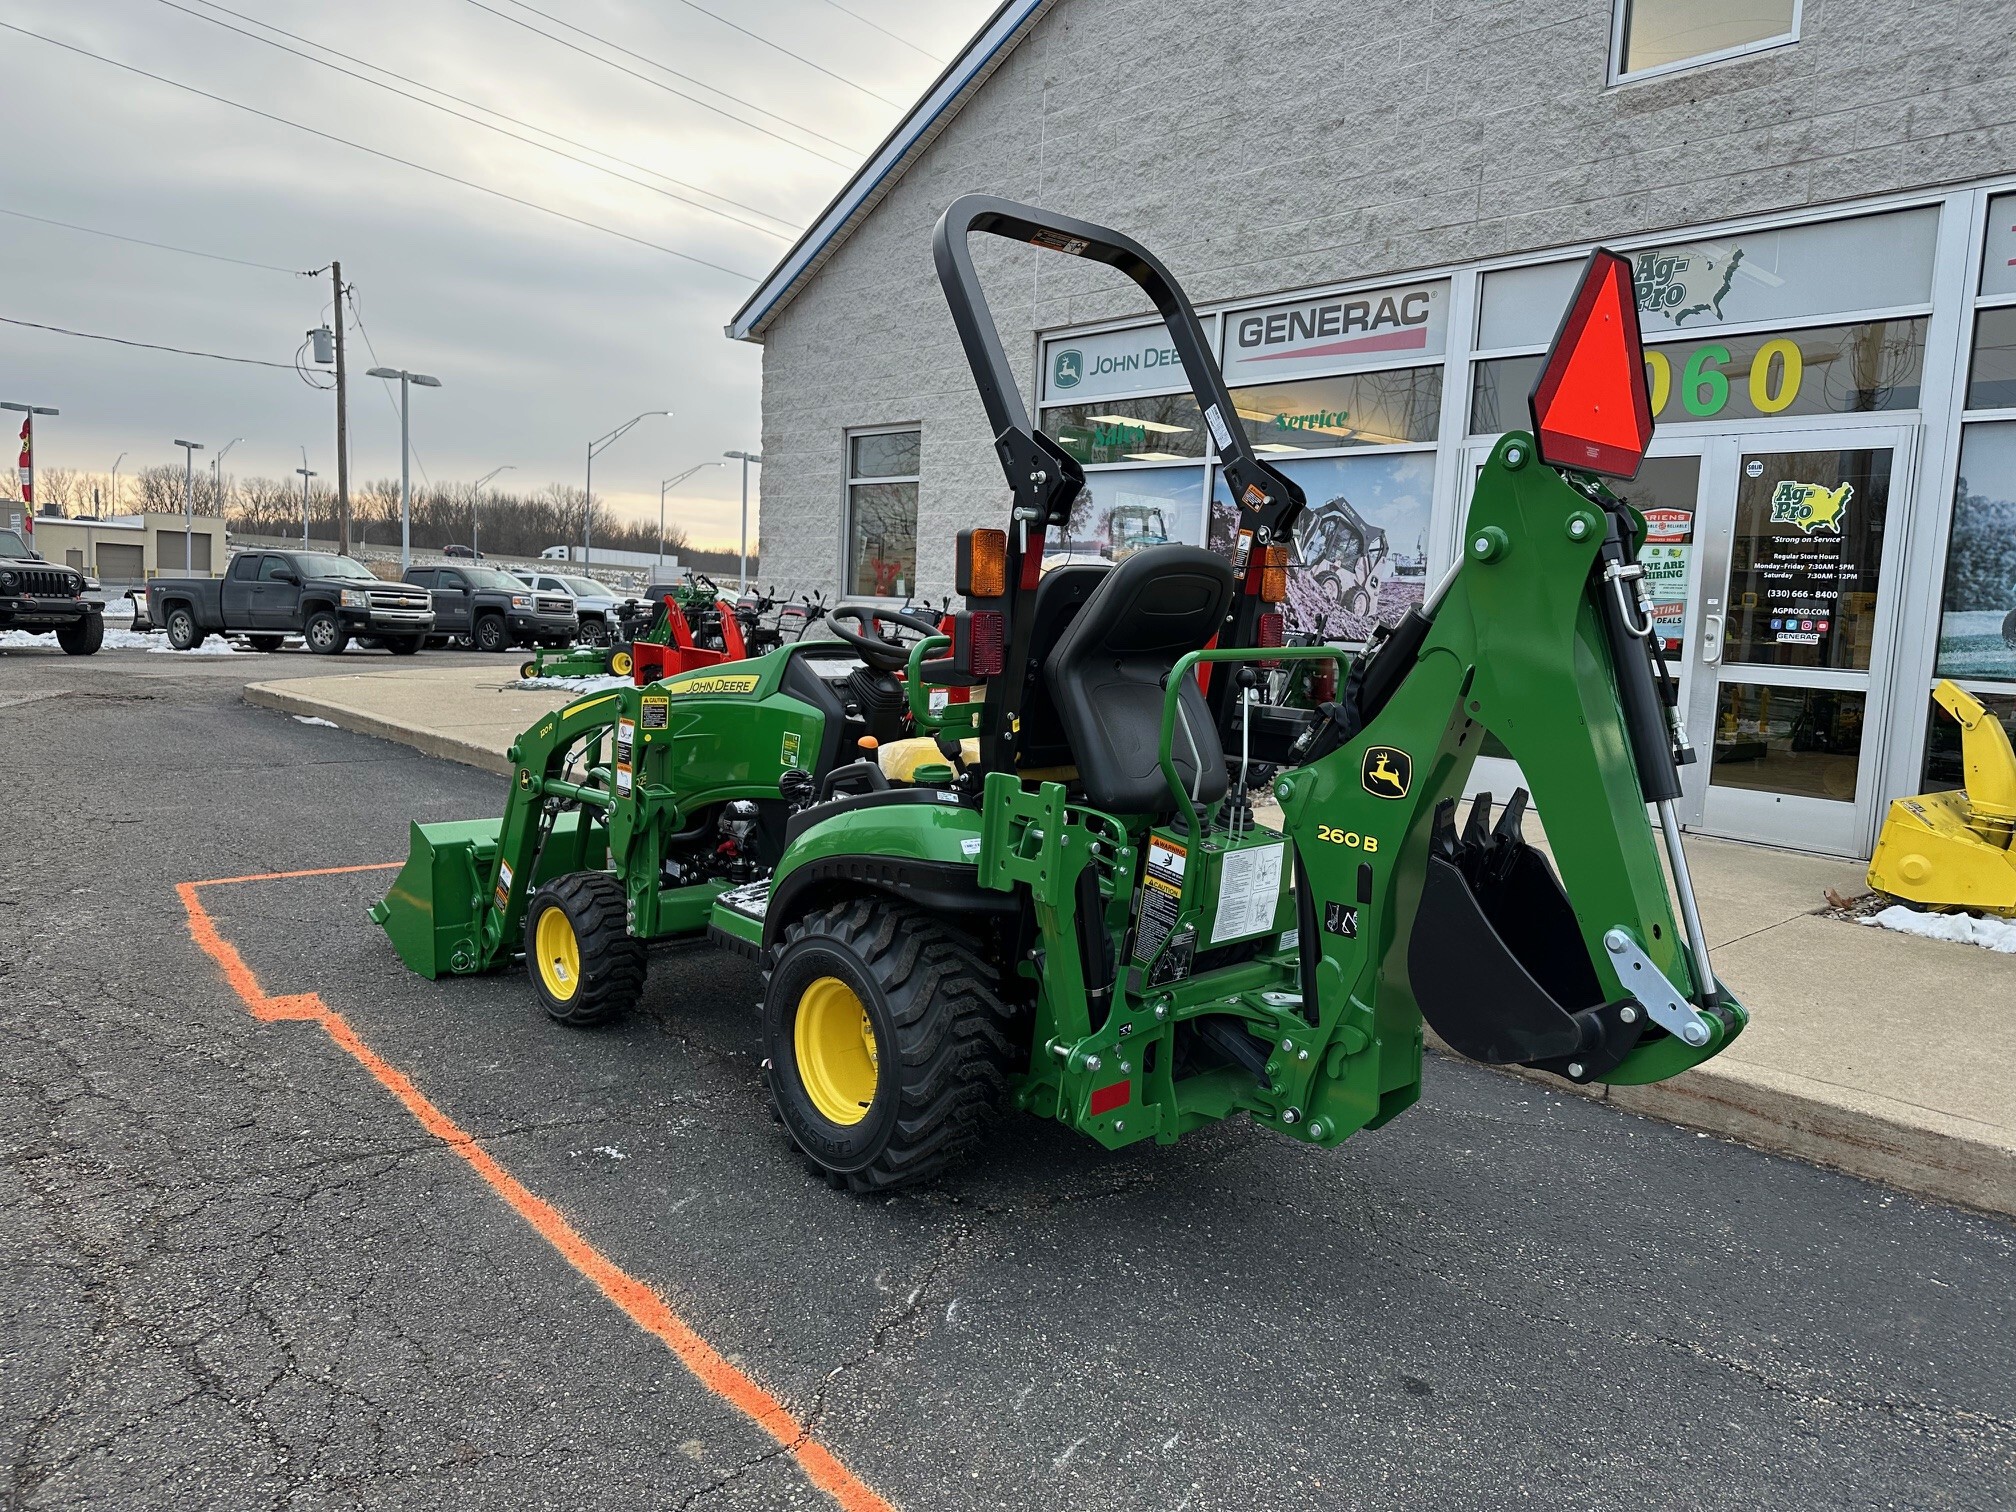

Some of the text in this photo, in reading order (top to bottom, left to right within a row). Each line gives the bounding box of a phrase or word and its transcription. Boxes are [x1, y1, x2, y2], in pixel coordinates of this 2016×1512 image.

[1634, 251, 1689, 285] Ag-
[1637, 281, 1687, 311] Pro
[1238, 291, 1430, 348] GENERAC
[1089, 347, 1182, 376] JOHN DEE
[1275, 408, 1350, 432] Service
[1775, 483, 1815, 505] Ag-
[1774, 501, 1813, 519] Pro
[1663, 560, 1685, 569] ARE
[1645, 569, 1683, 579] HIRING
[1767, 589, 1790, 598] (330)
[1791, 590, 1809, 598] 666
[1815, 590, 1838, 599] 8400
[1652, 604, 1682, 615] STIHL
[1772, 607, 1830, 616] AGPROCO.COM
[1777, 632, 1818, 640] GENERAC
[686, 679, 752, 692] JOHN DEERE
[1317, 824, 1379, 853] 260 B
[1159, 841, 1186, 857] WARNING
[1153, 881, 1179, 897] CAUTION
